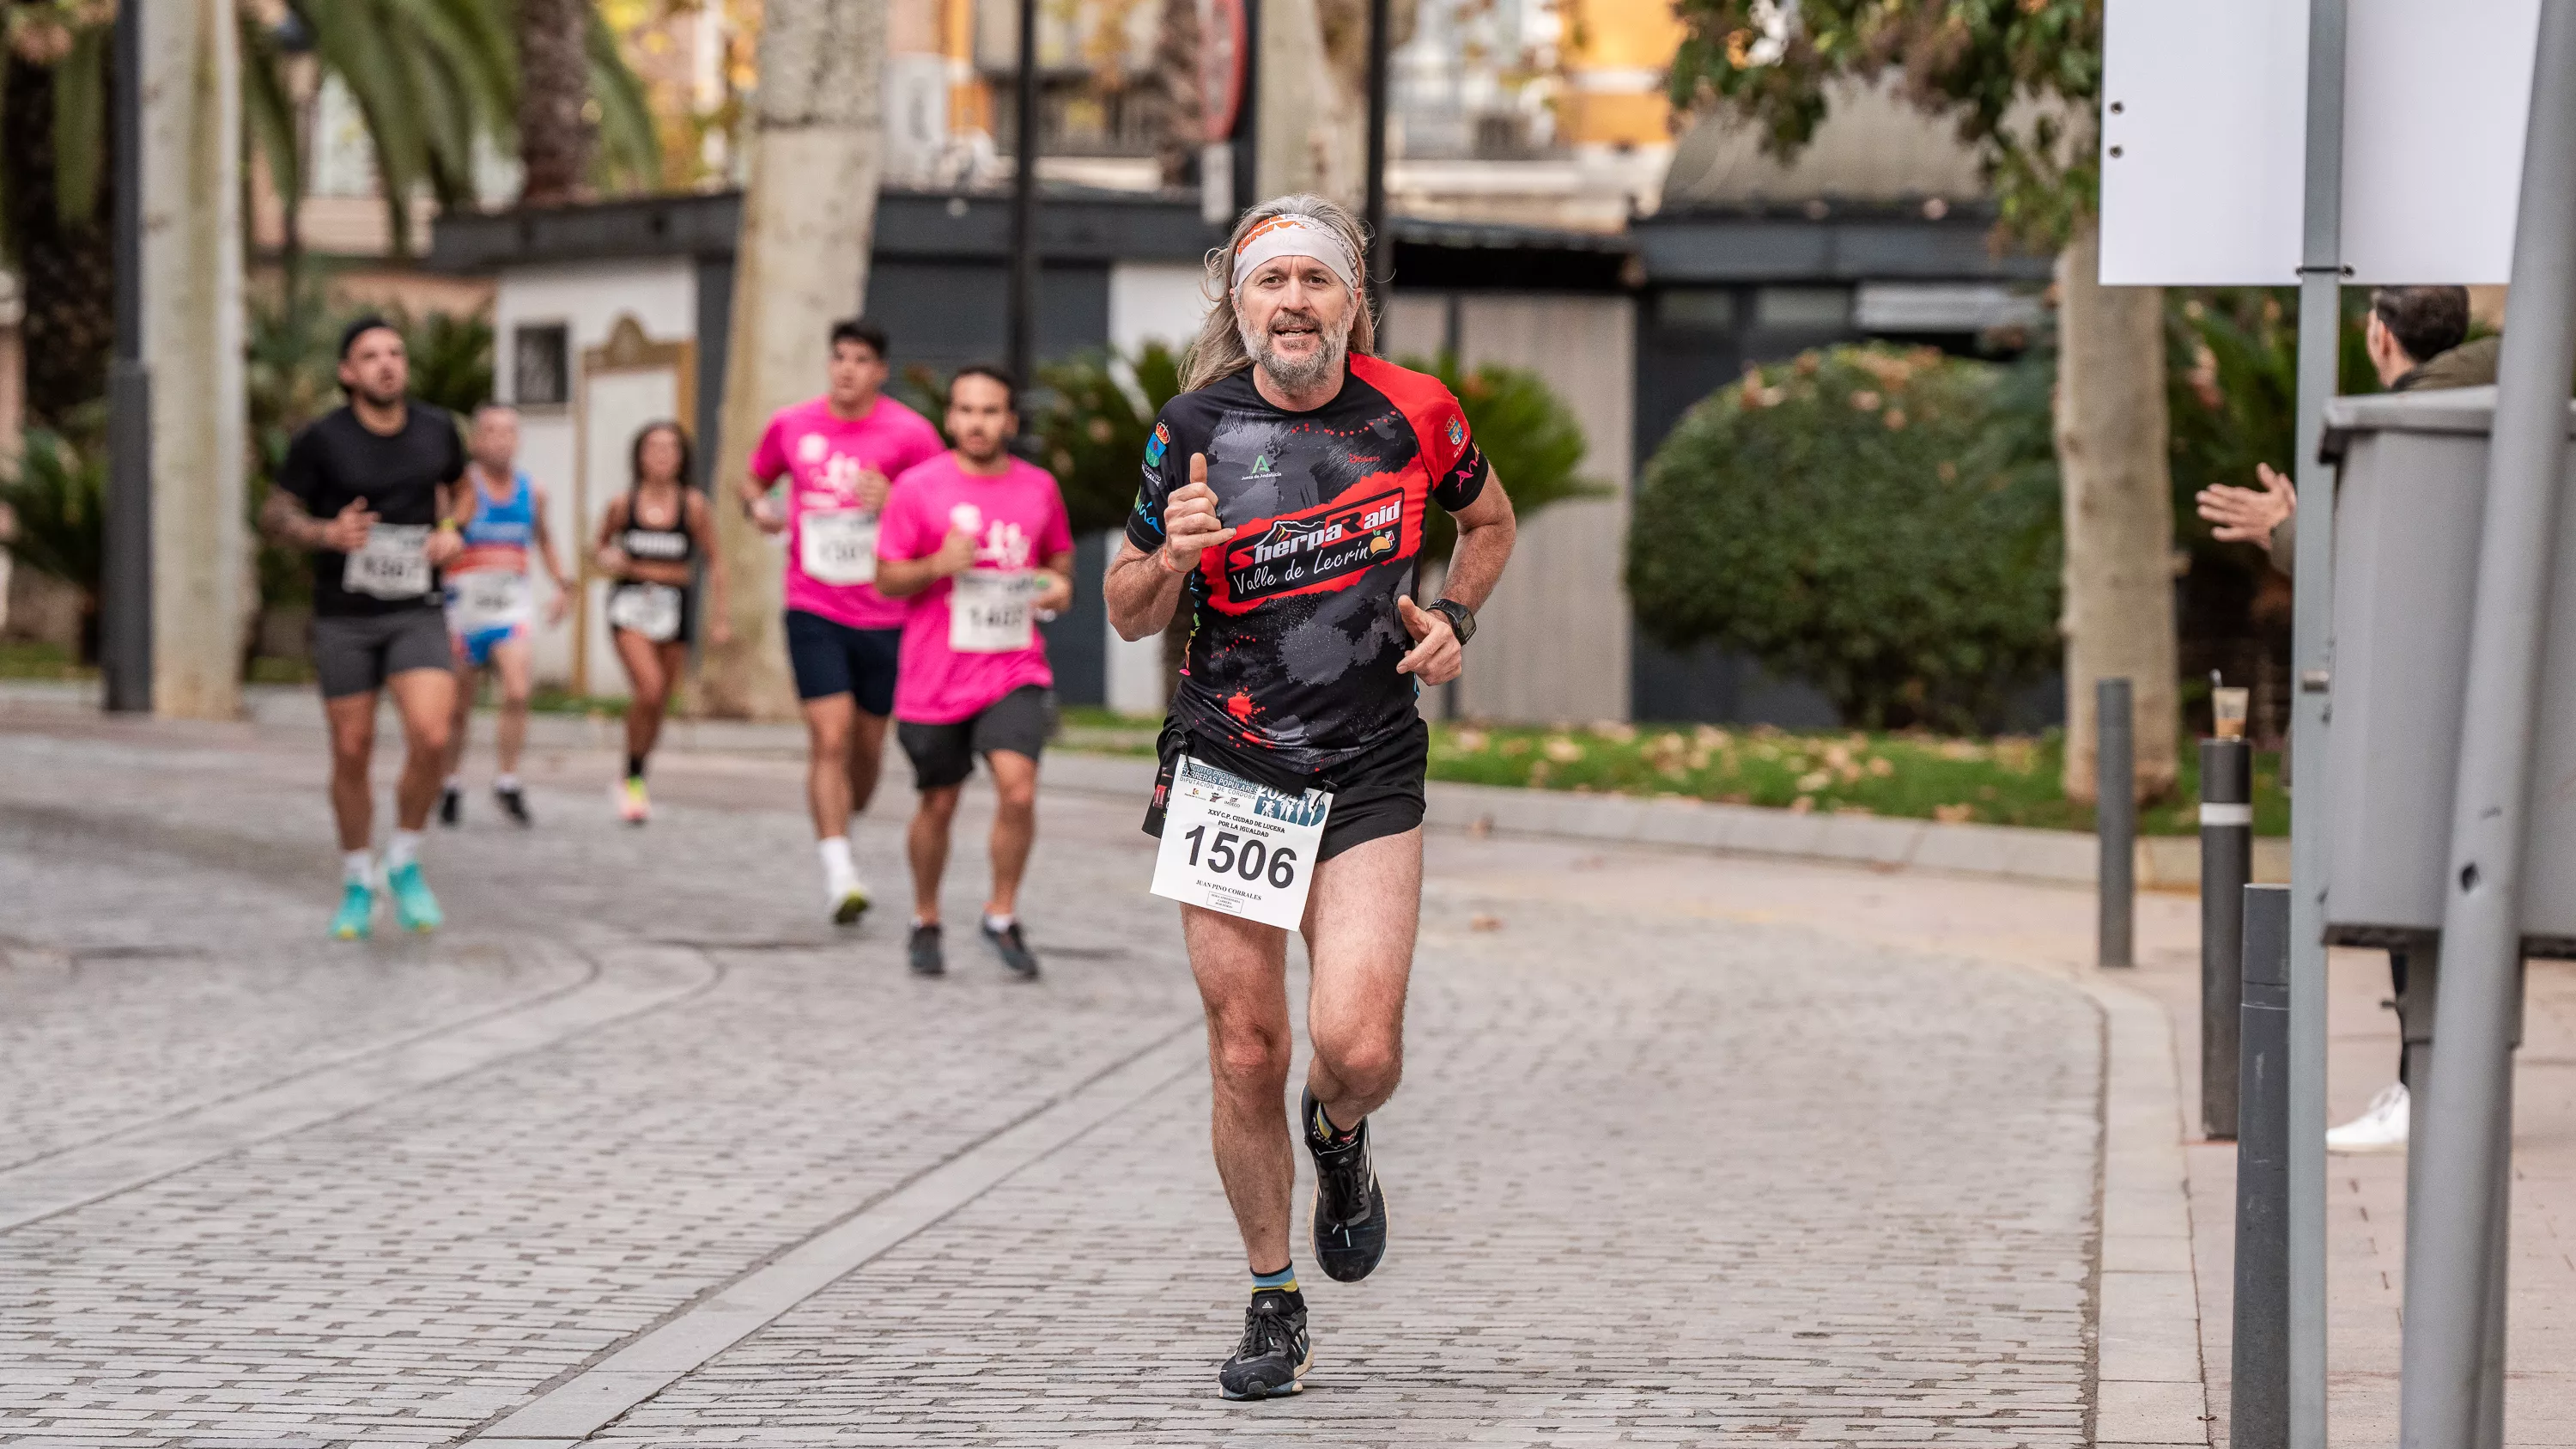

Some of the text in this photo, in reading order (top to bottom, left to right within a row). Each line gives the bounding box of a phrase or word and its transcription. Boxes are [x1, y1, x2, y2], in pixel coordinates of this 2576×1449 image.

[1233, 565, 1277, 594] Valle
[1285, 559, 1304, 581] de
[1213, 770, 1251, 785] PROVINCIAL
[1218, 778, 1258, 795] POPULARES
[1207, 808, 1221, 818] XXV
[1220, 812, 1231, 820] C.P.
[1232, 815, 1254, 825] CIUDAD
[1262, 823, 1285, 834] LUCENA
[1218, 819, 1270, 838] POR LA IGUALDAD
[1184, 825, 1297, 889] 1506
[1195, 880, 1262, 901] JUAN PINO CORRALES
